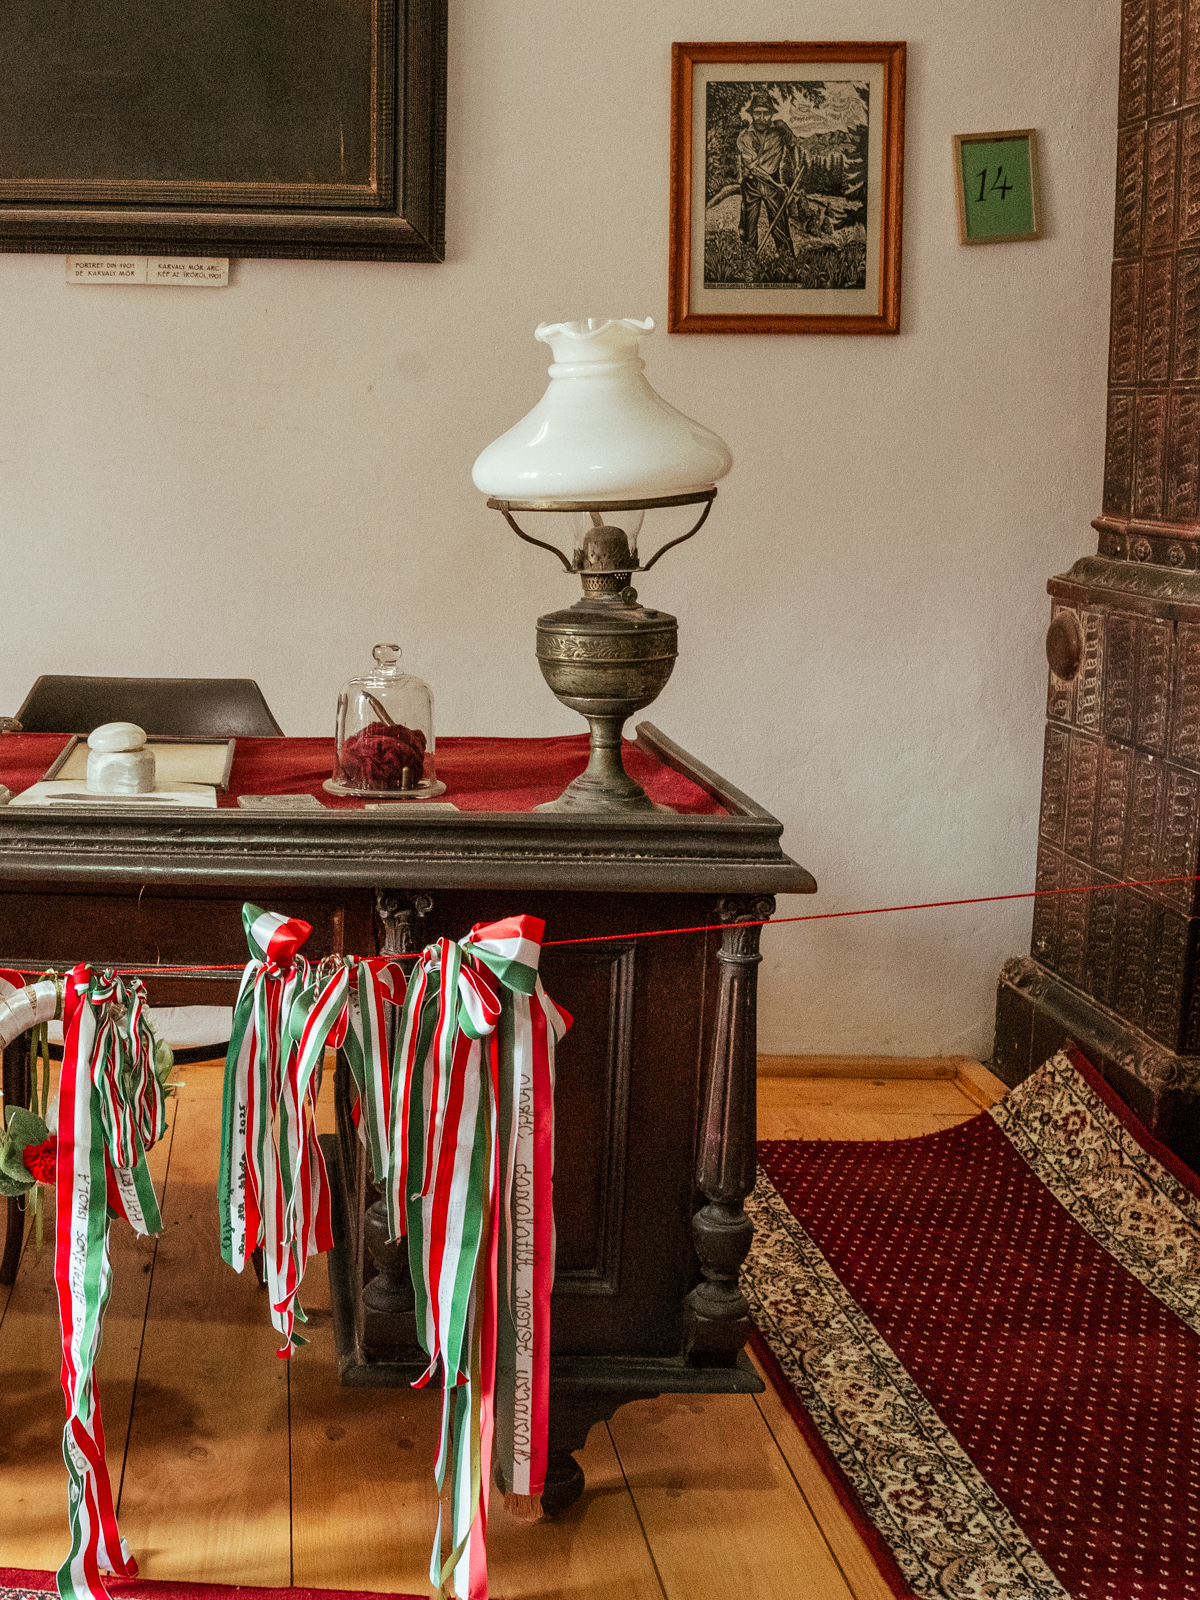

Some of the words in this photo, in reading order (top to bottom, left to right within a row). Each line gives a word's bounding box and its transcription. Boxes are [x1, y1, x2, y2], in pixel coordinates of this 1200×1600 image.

[974, 165, 1014, 203] 14
[118, 269, 135, 277] MÓR
[157, 269, 170, 277] KÉP
[188, 262, 204, 271] MÓR
[238, 1102, 246, 1136] 2025
[76, 1173, 91, 1221] ISKOLA
[119, 1168, 143, 1222] HATÁRT
[72, 1230, 88, 1306] ÁLTALÁNOS
